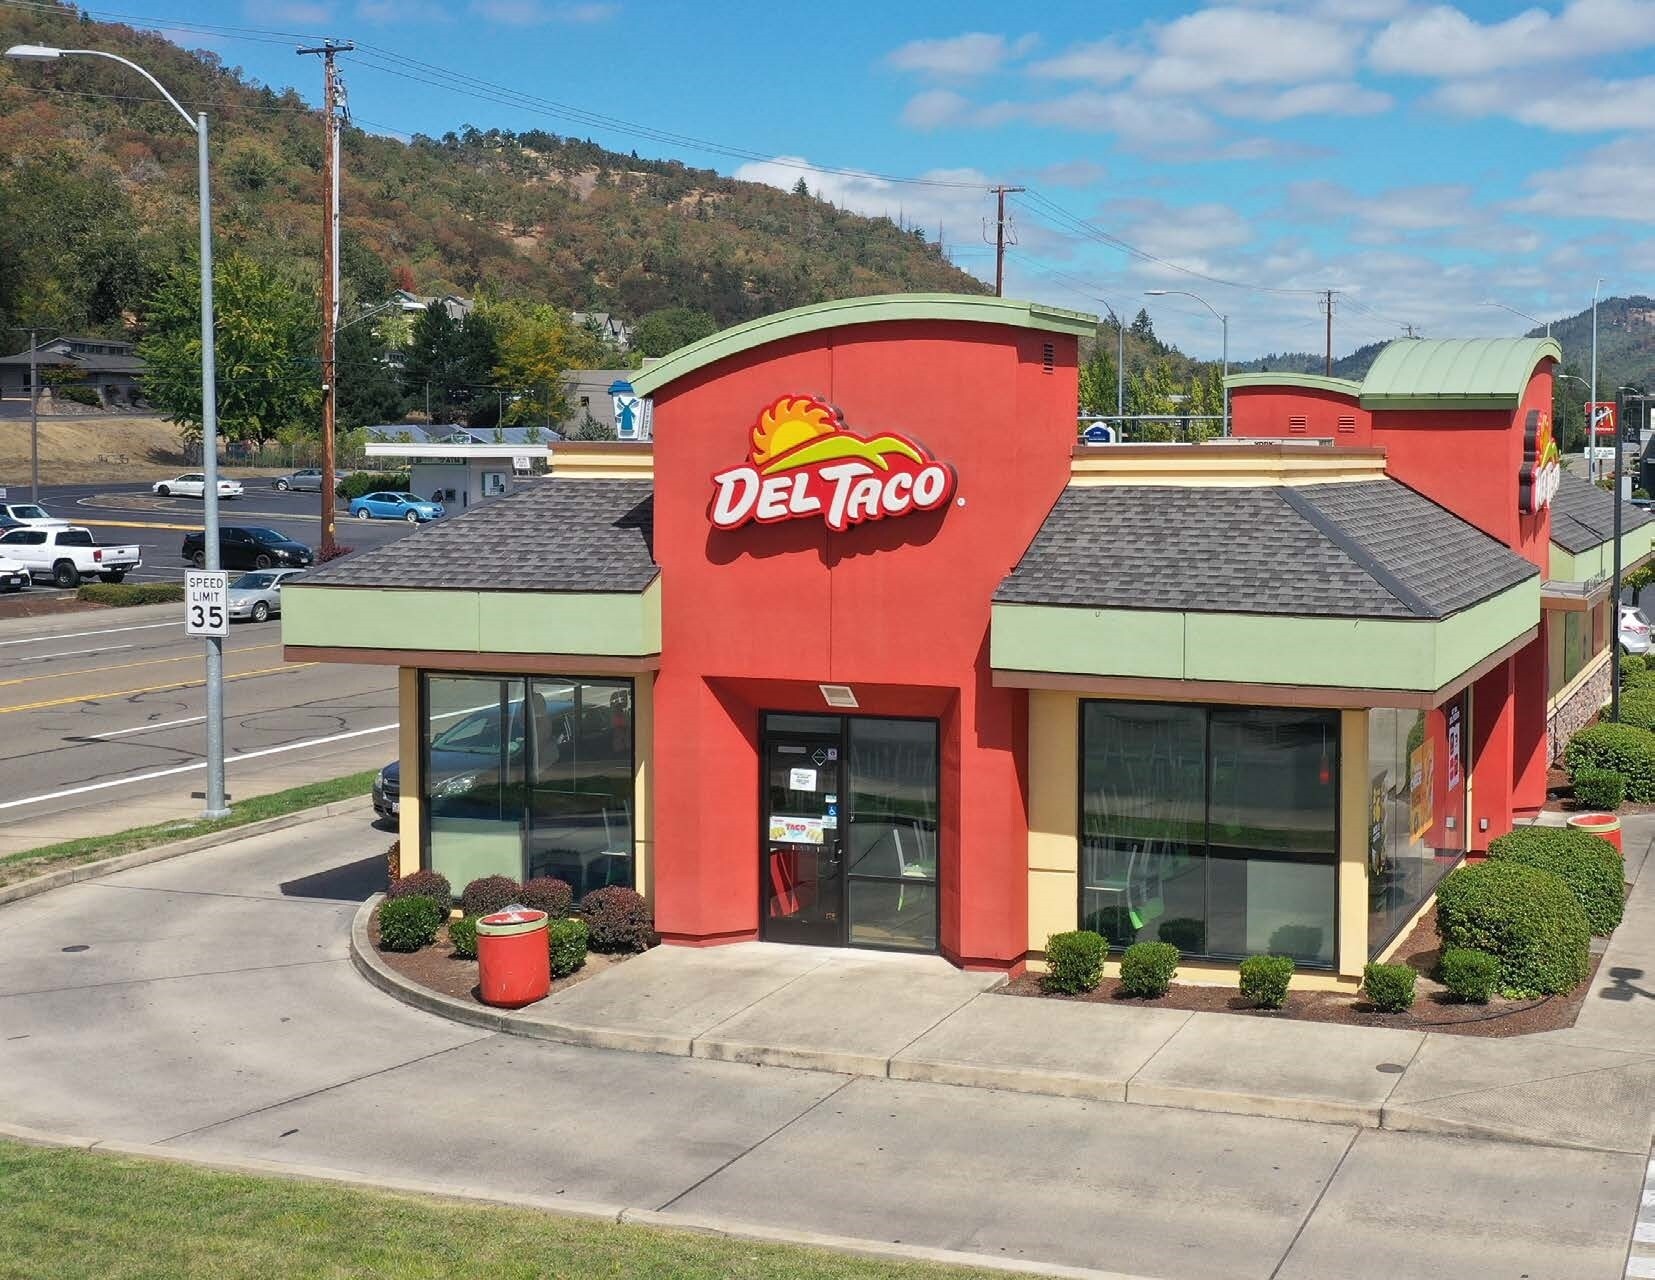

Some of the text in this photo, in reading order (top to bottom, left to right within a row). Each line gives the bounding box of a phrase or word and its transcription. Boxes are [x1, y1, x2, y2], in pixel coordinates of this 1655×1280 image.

[189, 577, 224, 589] SPEED
[192, 591, 220, 602] LIMIT
[191, 605, 223, 629] 35
[785, 823, 807, 831] TACO
